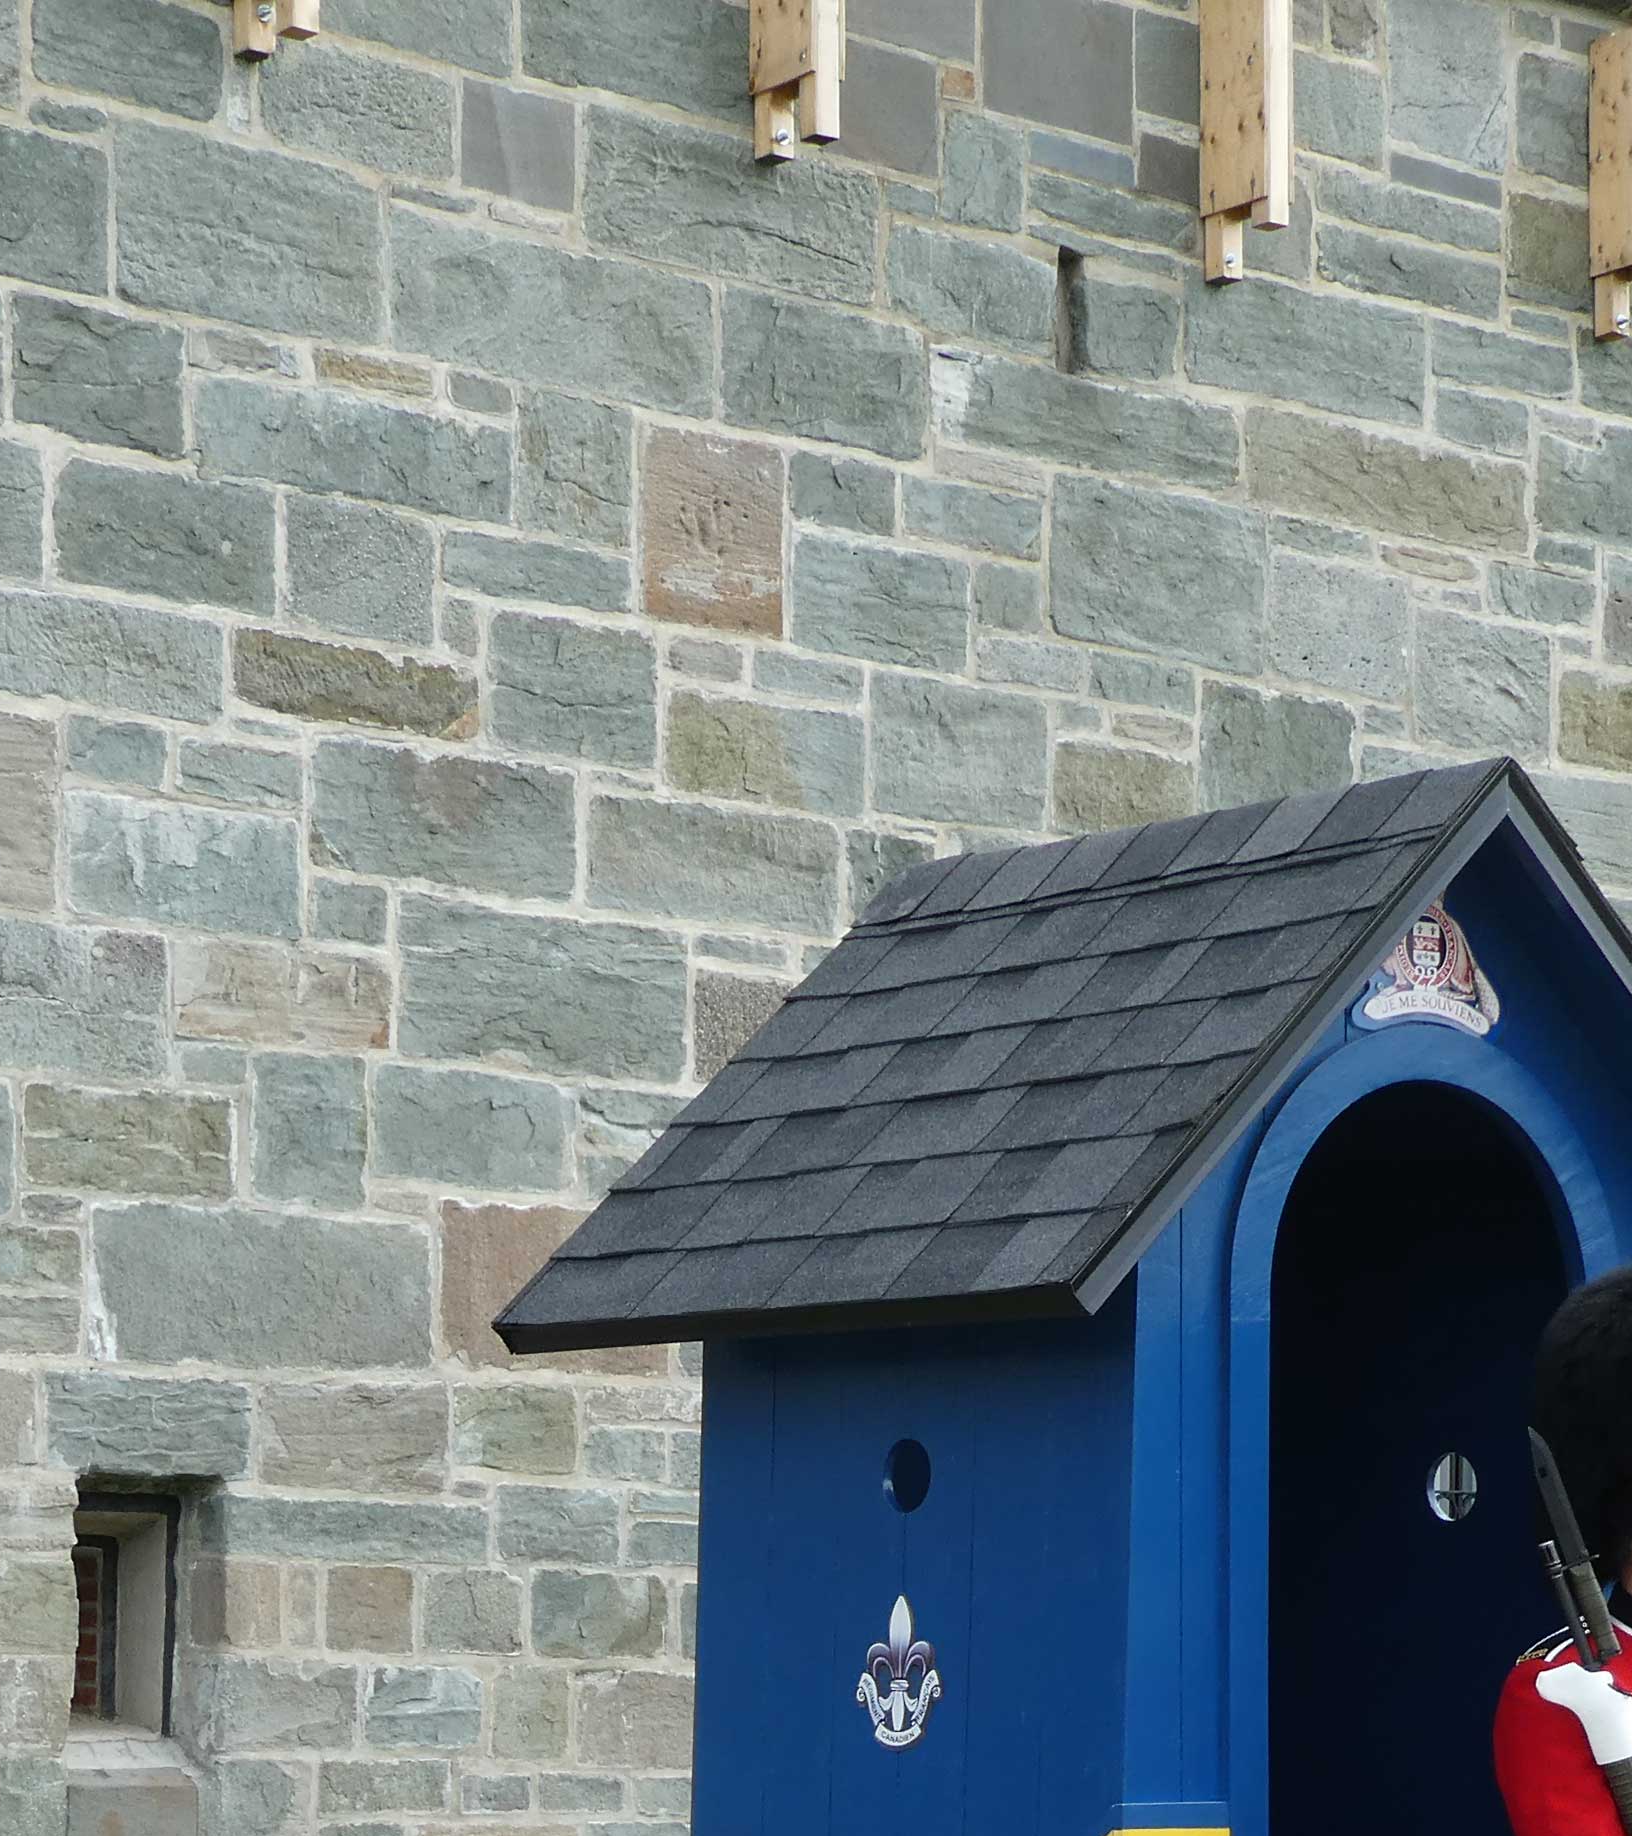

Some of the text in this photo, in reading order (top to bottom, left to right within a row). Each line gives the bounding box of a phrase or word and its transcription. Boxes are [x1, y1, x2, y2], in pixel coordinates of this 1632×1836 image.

[1382, 995, 1482, 1027] JE ME SOUVIENS
[880, 1730, 915, 1743] CANADIEN
